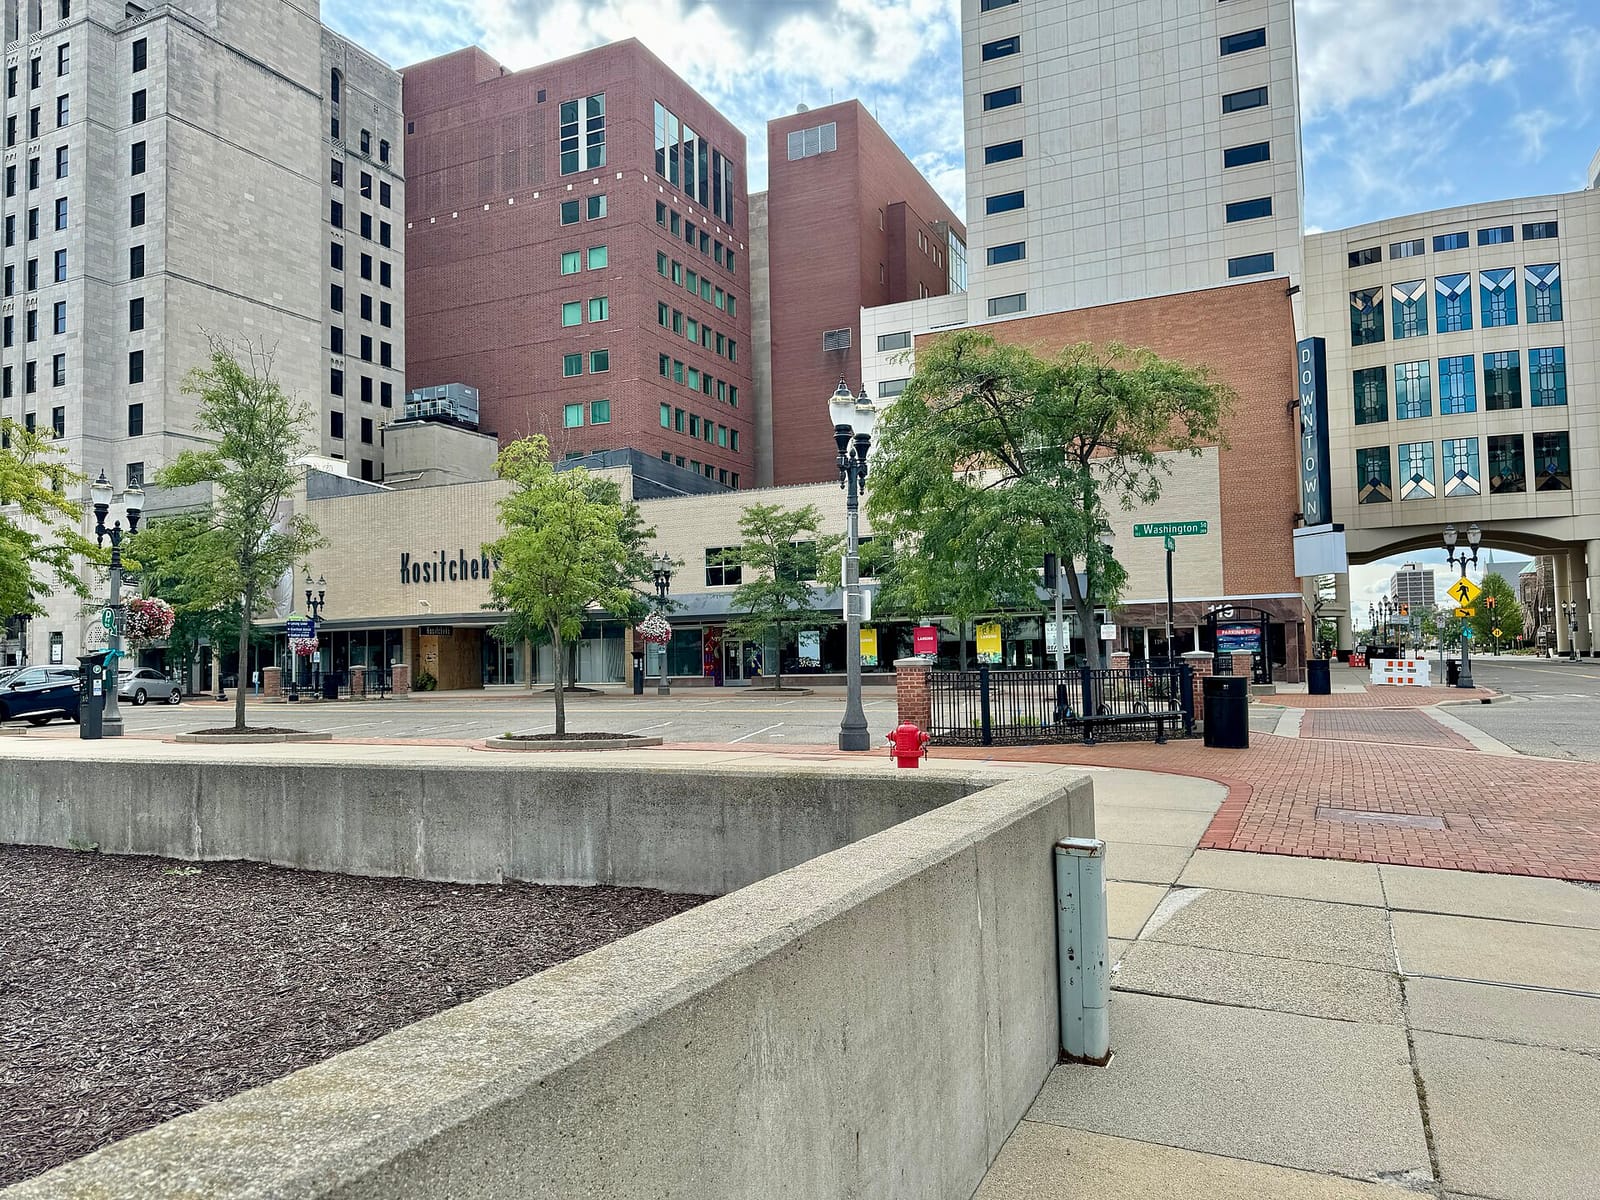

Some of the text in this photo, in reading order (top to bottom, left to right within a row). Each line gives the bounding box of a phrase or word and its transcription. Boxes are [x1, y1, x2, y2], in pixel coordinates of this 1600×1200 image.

[1302, 348, 1317, 515] DOWNTOWN
[1143, 523, 1198, 535] Washington
[1207, 604, 1234, 618] 119
